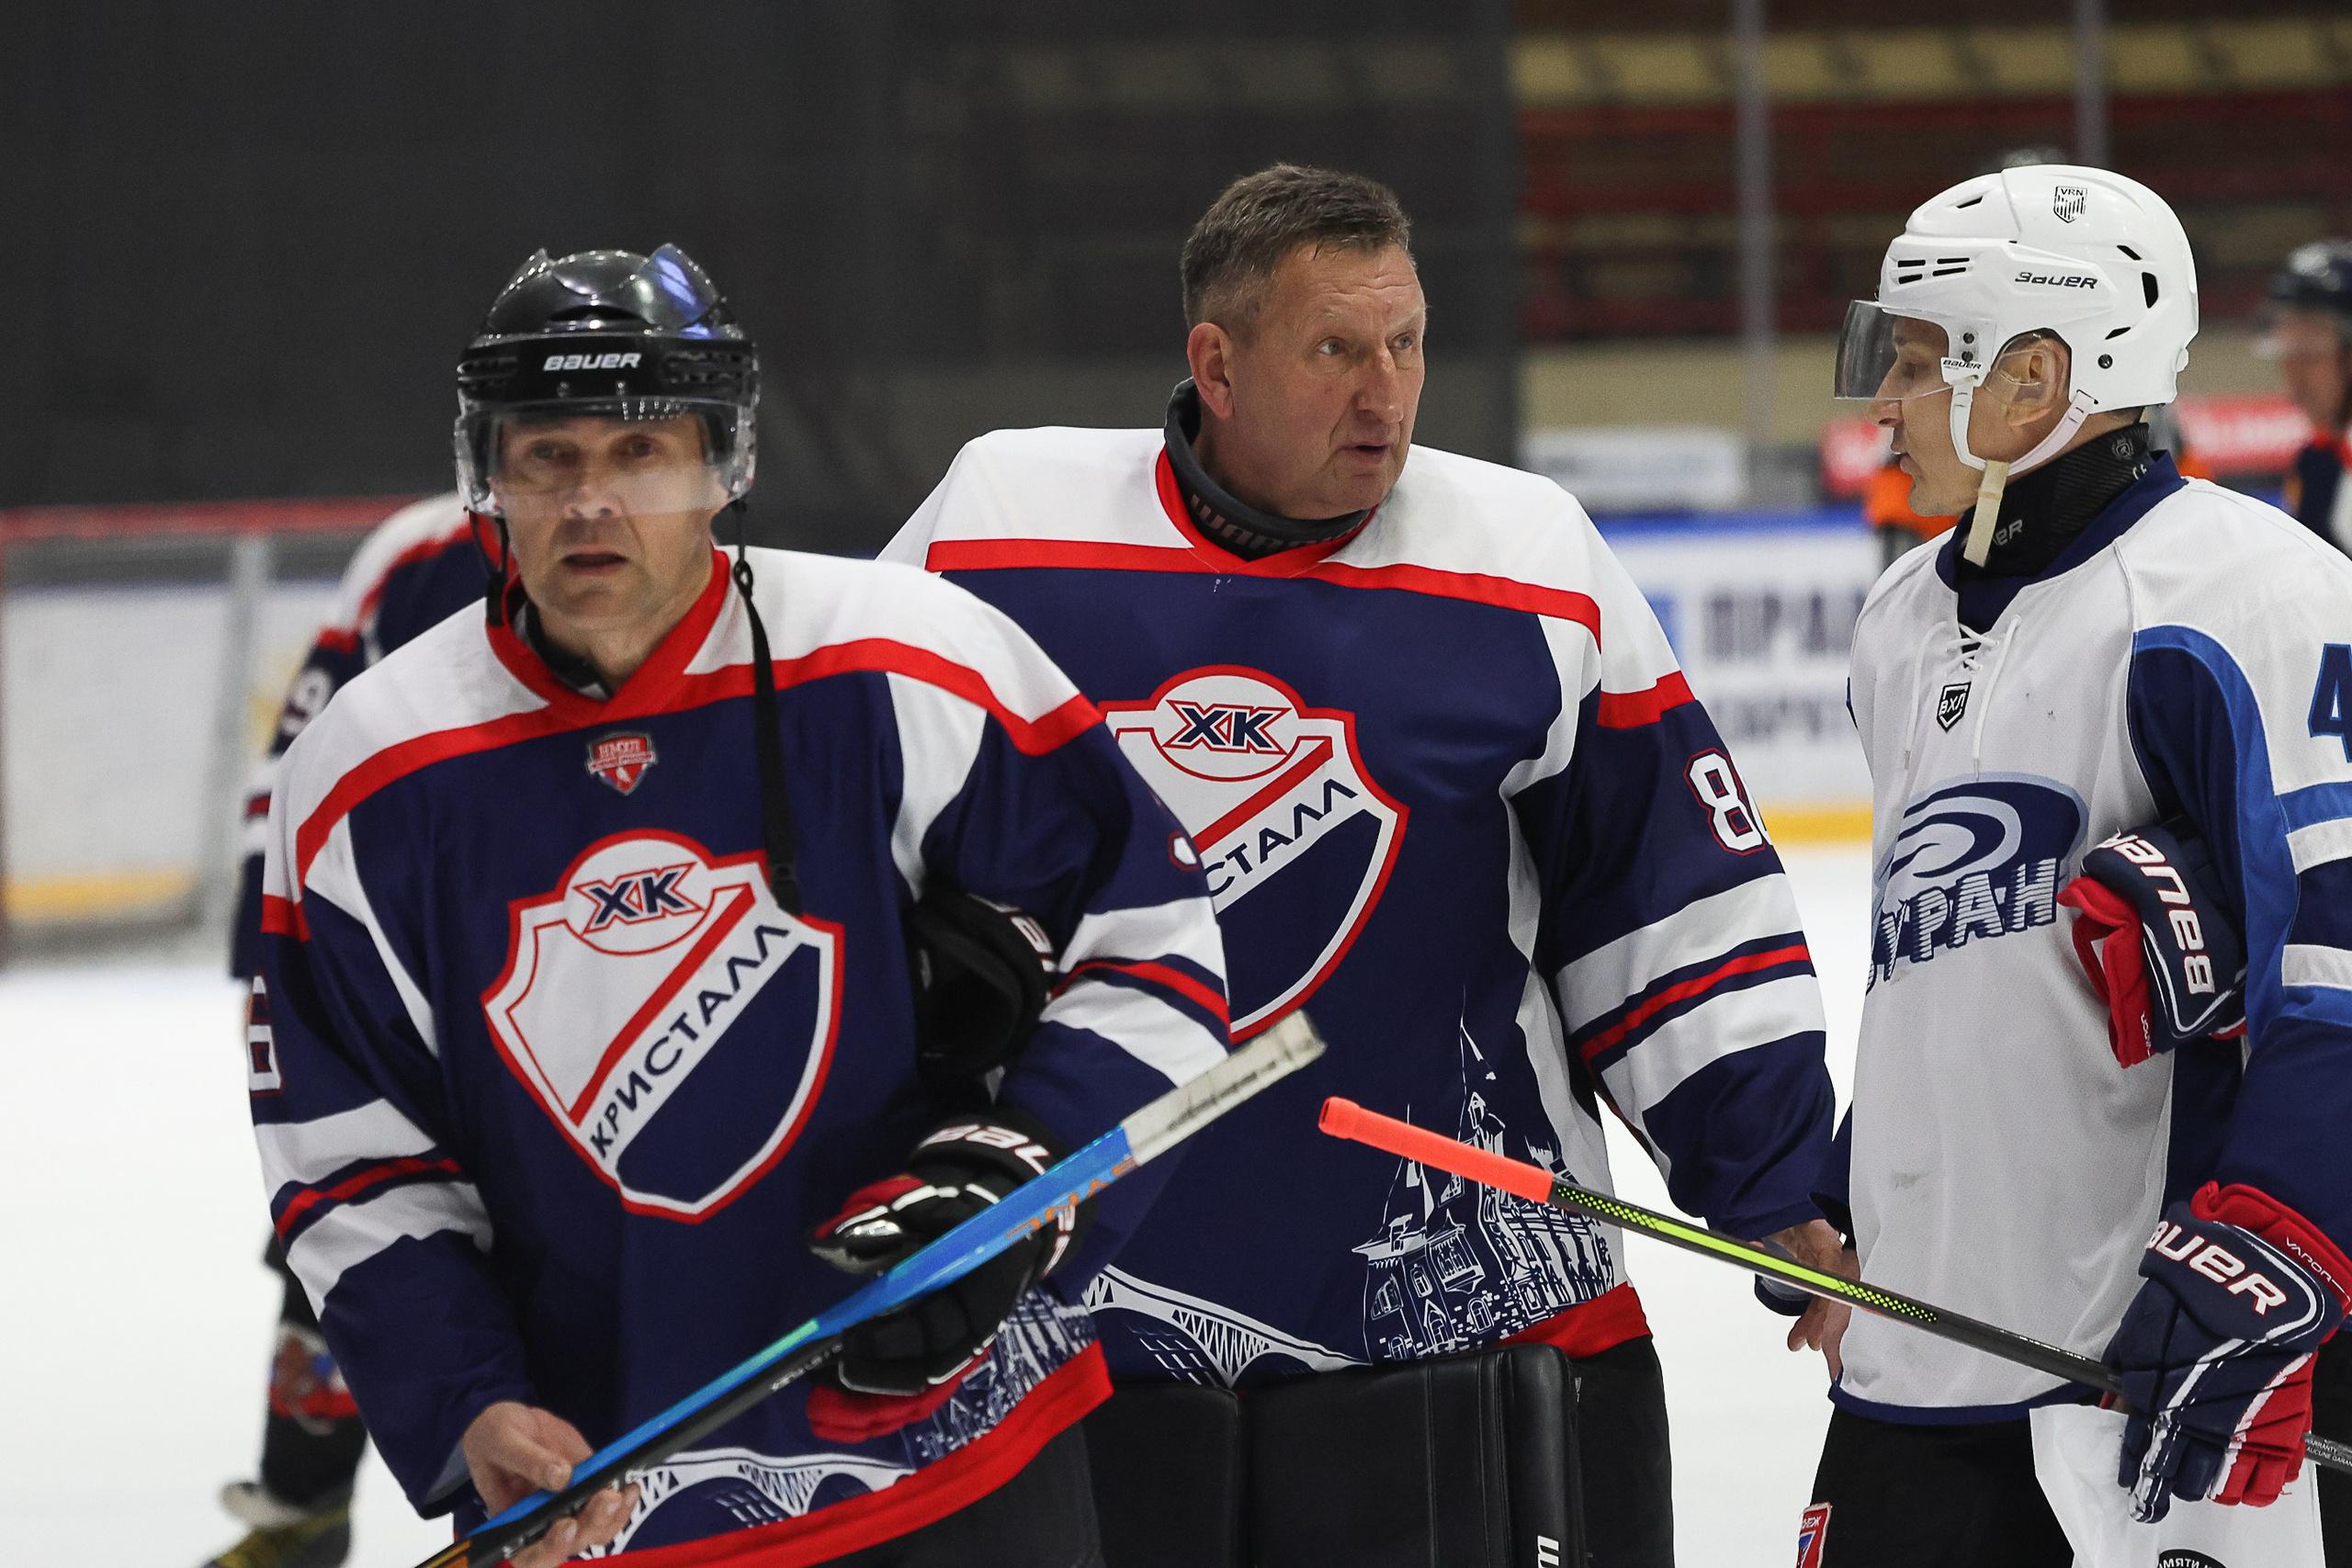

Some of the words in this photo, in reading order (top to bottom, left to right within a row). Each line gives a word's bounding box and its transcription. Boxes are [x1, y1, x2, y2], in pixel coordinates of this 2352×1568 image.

[2015, 272, 2098, 289] BAUER
[542, 353, 641, 371] BAUER
[1943, 359, 1982, 369] BAUER
[1168, 703, 1284, 753] ХК
[1939, 693, 1966, 716] ВХЛ
[1684, 748, 1770, 855] 8
[1204, 779, 1359, 897] СТАЛЛ
[579, 866, 697, 931] ХК
[1866, 856, 2061, 996] УРАН
[590, 924, 790, 1158] КРИСТАЛЛ
[2144, 1221, 2287, 1315] AUER
[2286, 1236, 2335, 1284] VAPOR
[2332, 1455, 2352, 1467] GARAN
[2159, 1557, 2200, 1568] МЯТИ
